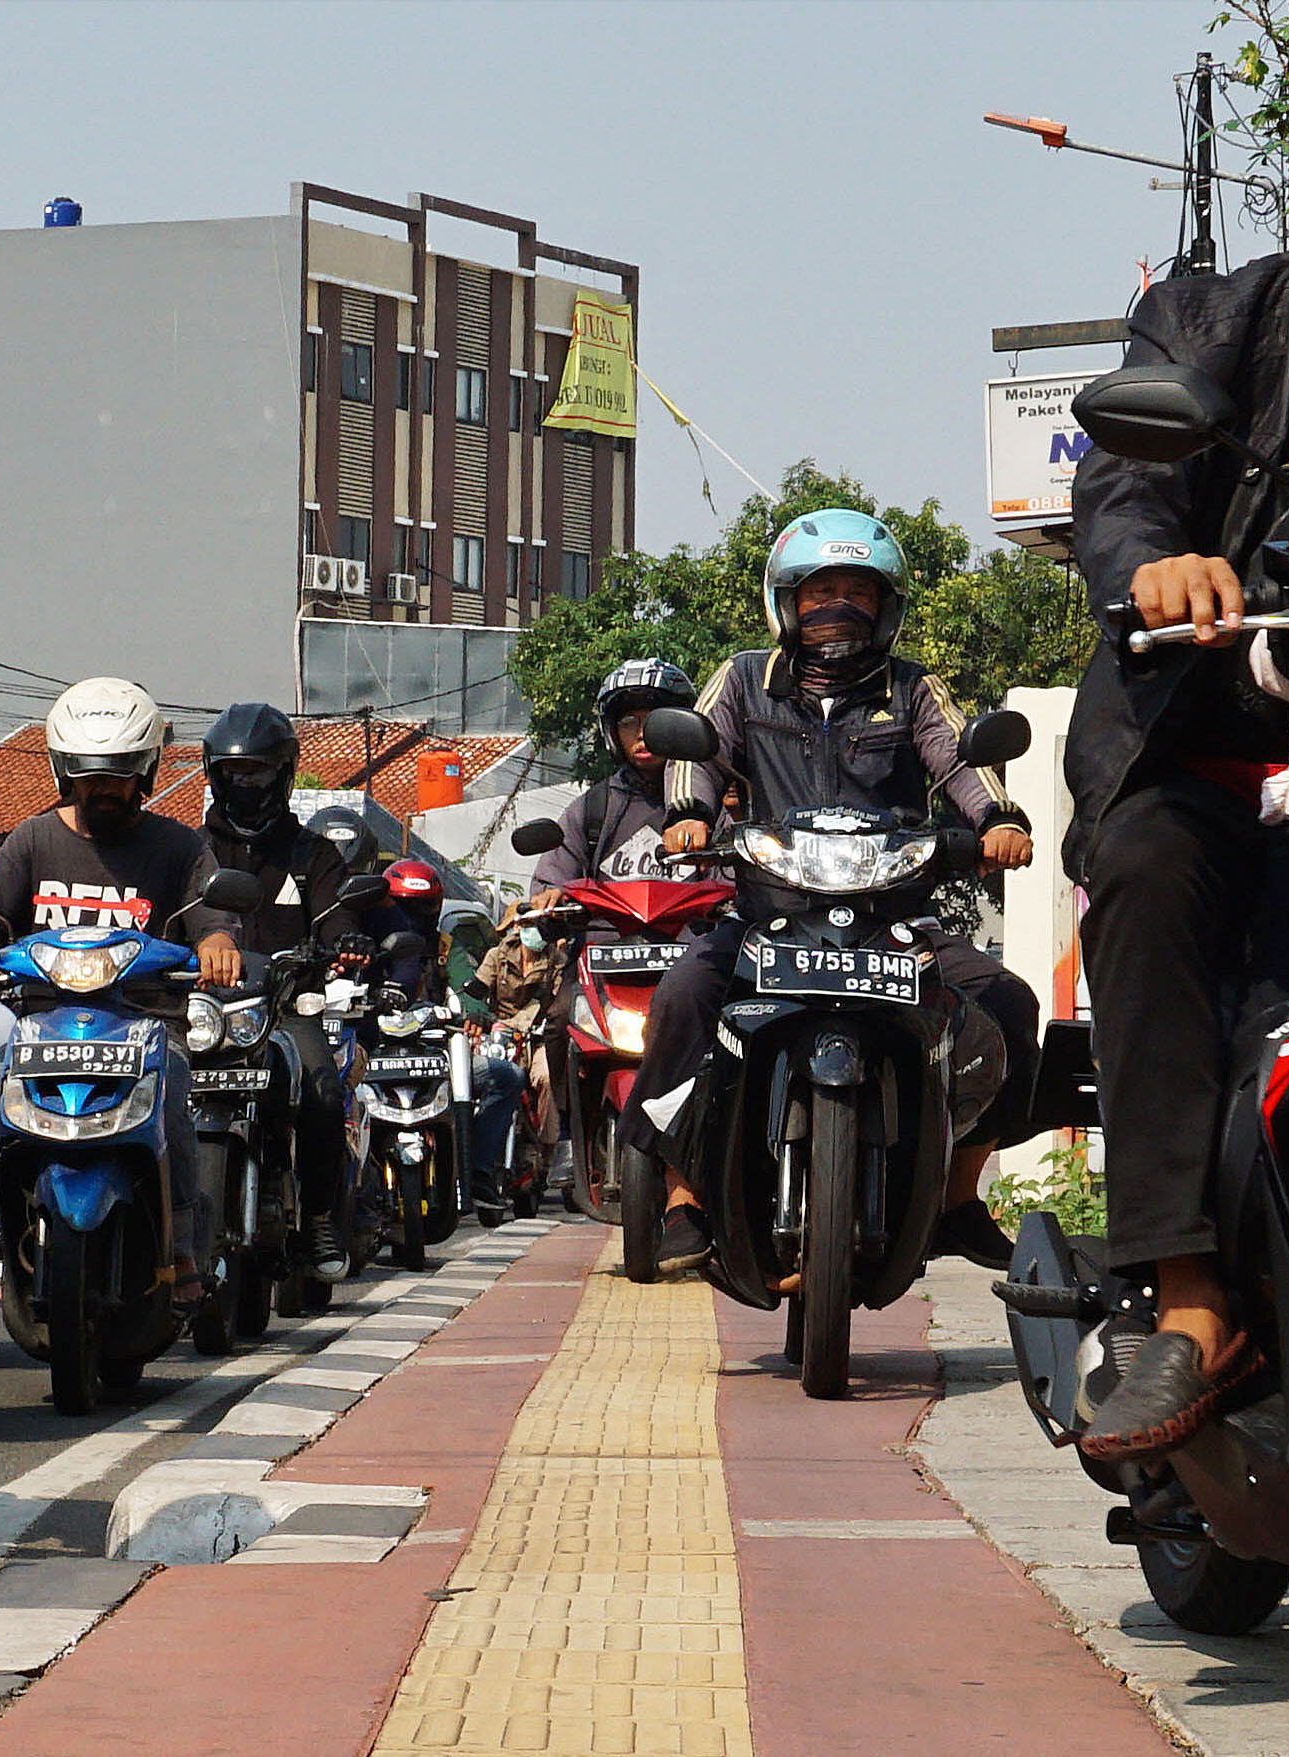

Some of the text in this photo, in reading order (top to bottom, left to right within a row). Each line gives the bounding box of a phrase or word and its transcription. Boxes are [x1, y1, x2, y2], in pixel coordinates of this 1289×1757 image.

[1005, 384, 1077, 400] Melayani
[1018, 403, 1063, 418] Paket
[591, 949, 603, 960] B
[761, 947, 914, 979] B 6755 BMR
[20, 1046, 32, 1063] B
[42, 1045, 95, 1062] 6530
